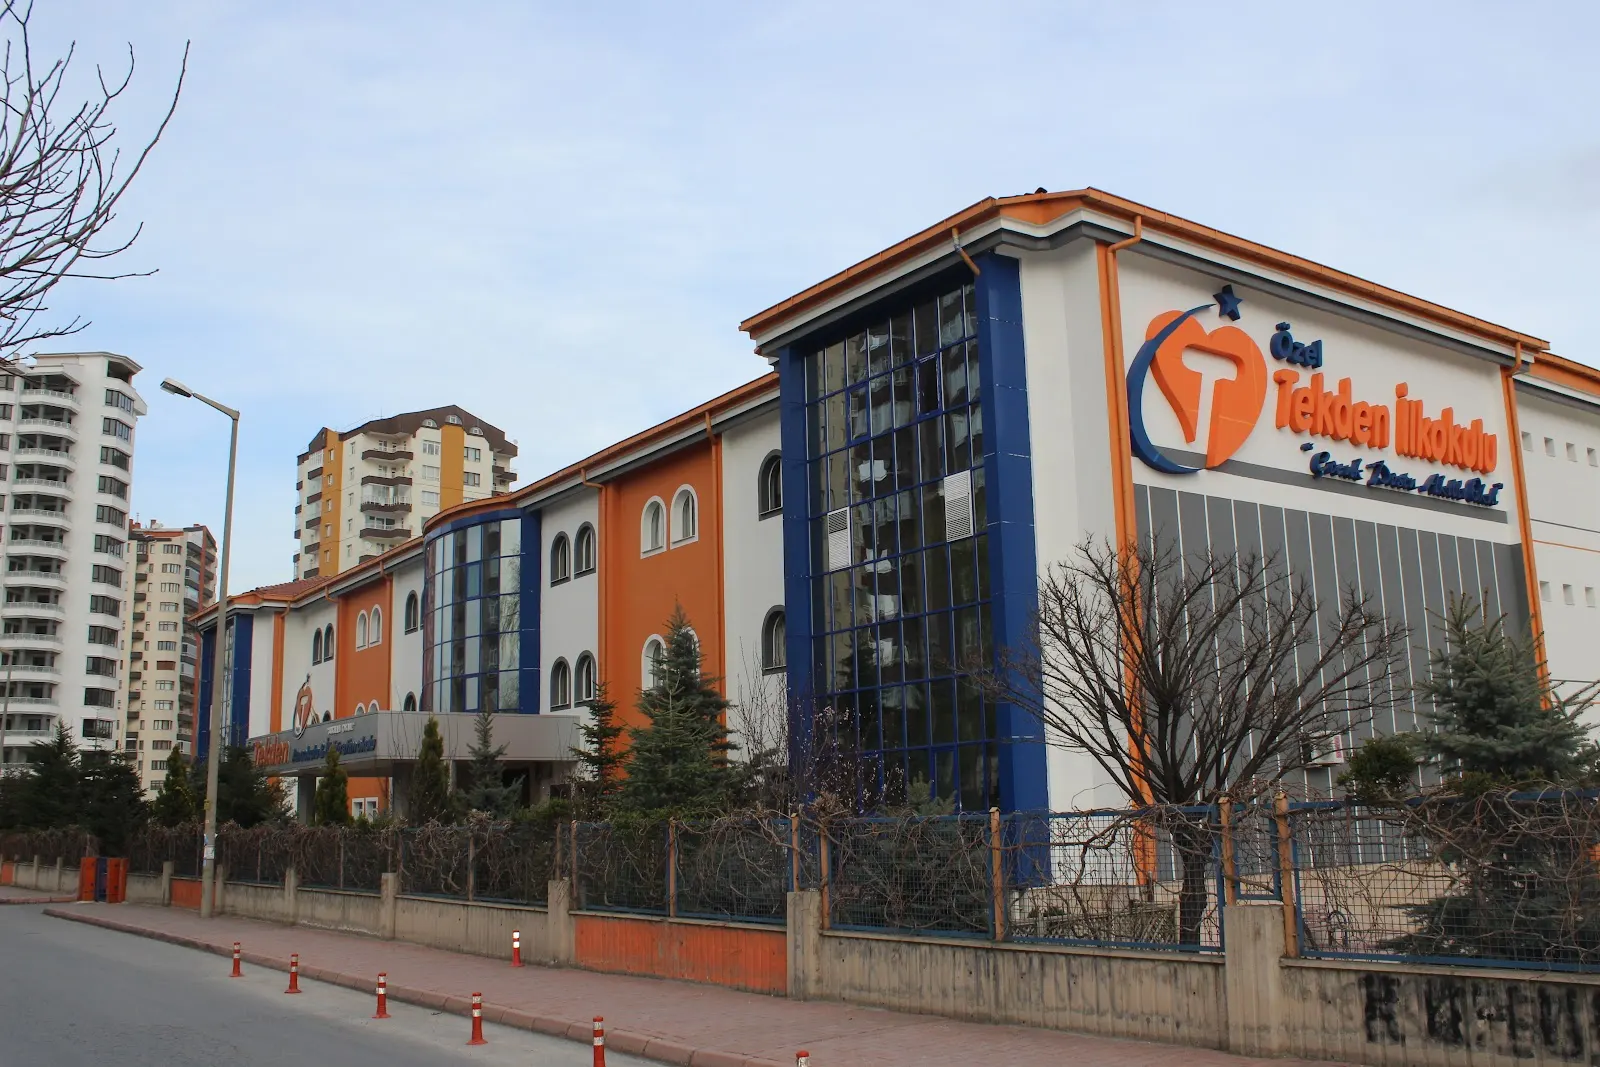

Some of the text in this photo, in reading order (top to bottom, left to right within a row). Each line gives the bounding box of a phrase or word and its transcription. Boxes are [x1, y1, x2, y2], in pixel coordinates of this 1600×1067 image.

[1270, 321, 1323, 368] Özel
[1273, 369, 1497, 475] Tekden İlkokulu
[254, 734, 289, 768] Tekden
